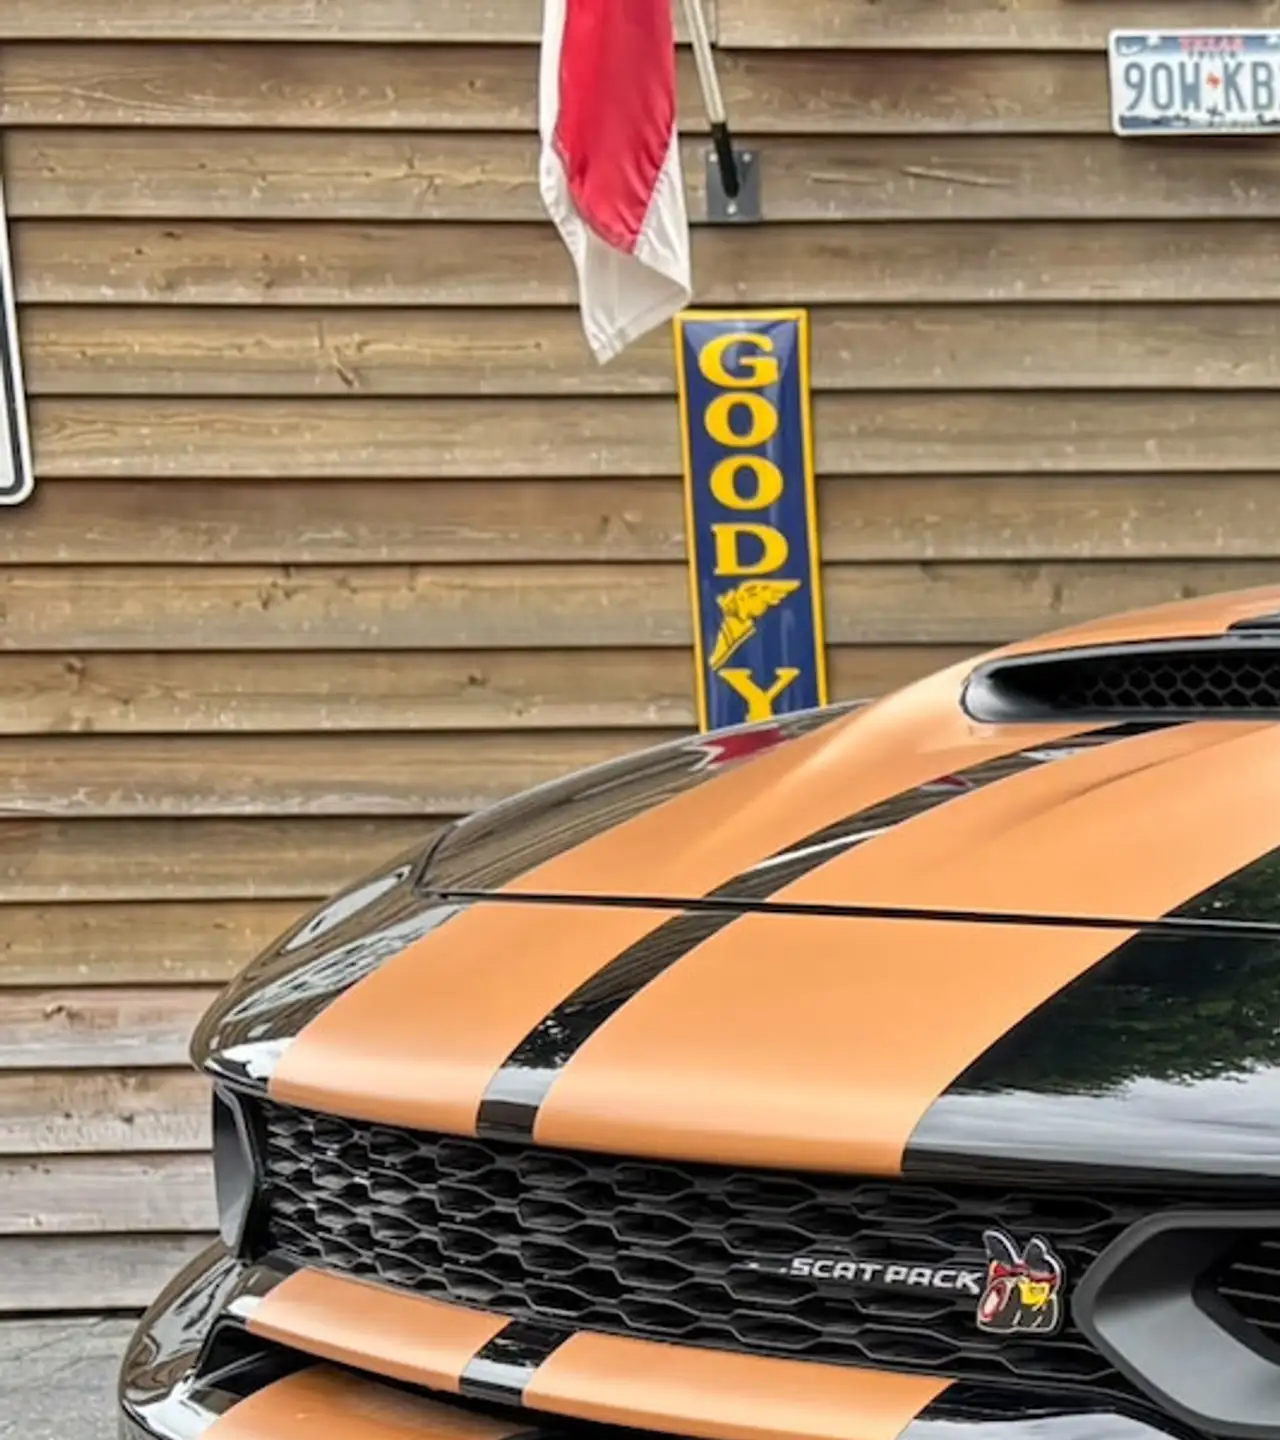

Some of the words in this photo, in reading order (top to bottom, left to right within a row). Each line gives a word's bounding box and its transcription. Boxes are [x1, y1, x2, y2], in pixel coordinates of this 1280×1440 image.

[698, 332, 801, 723] GOODY
[790, 1257, 884, 1281] SCAT
[884, 1264, 984, 1295] PACK
